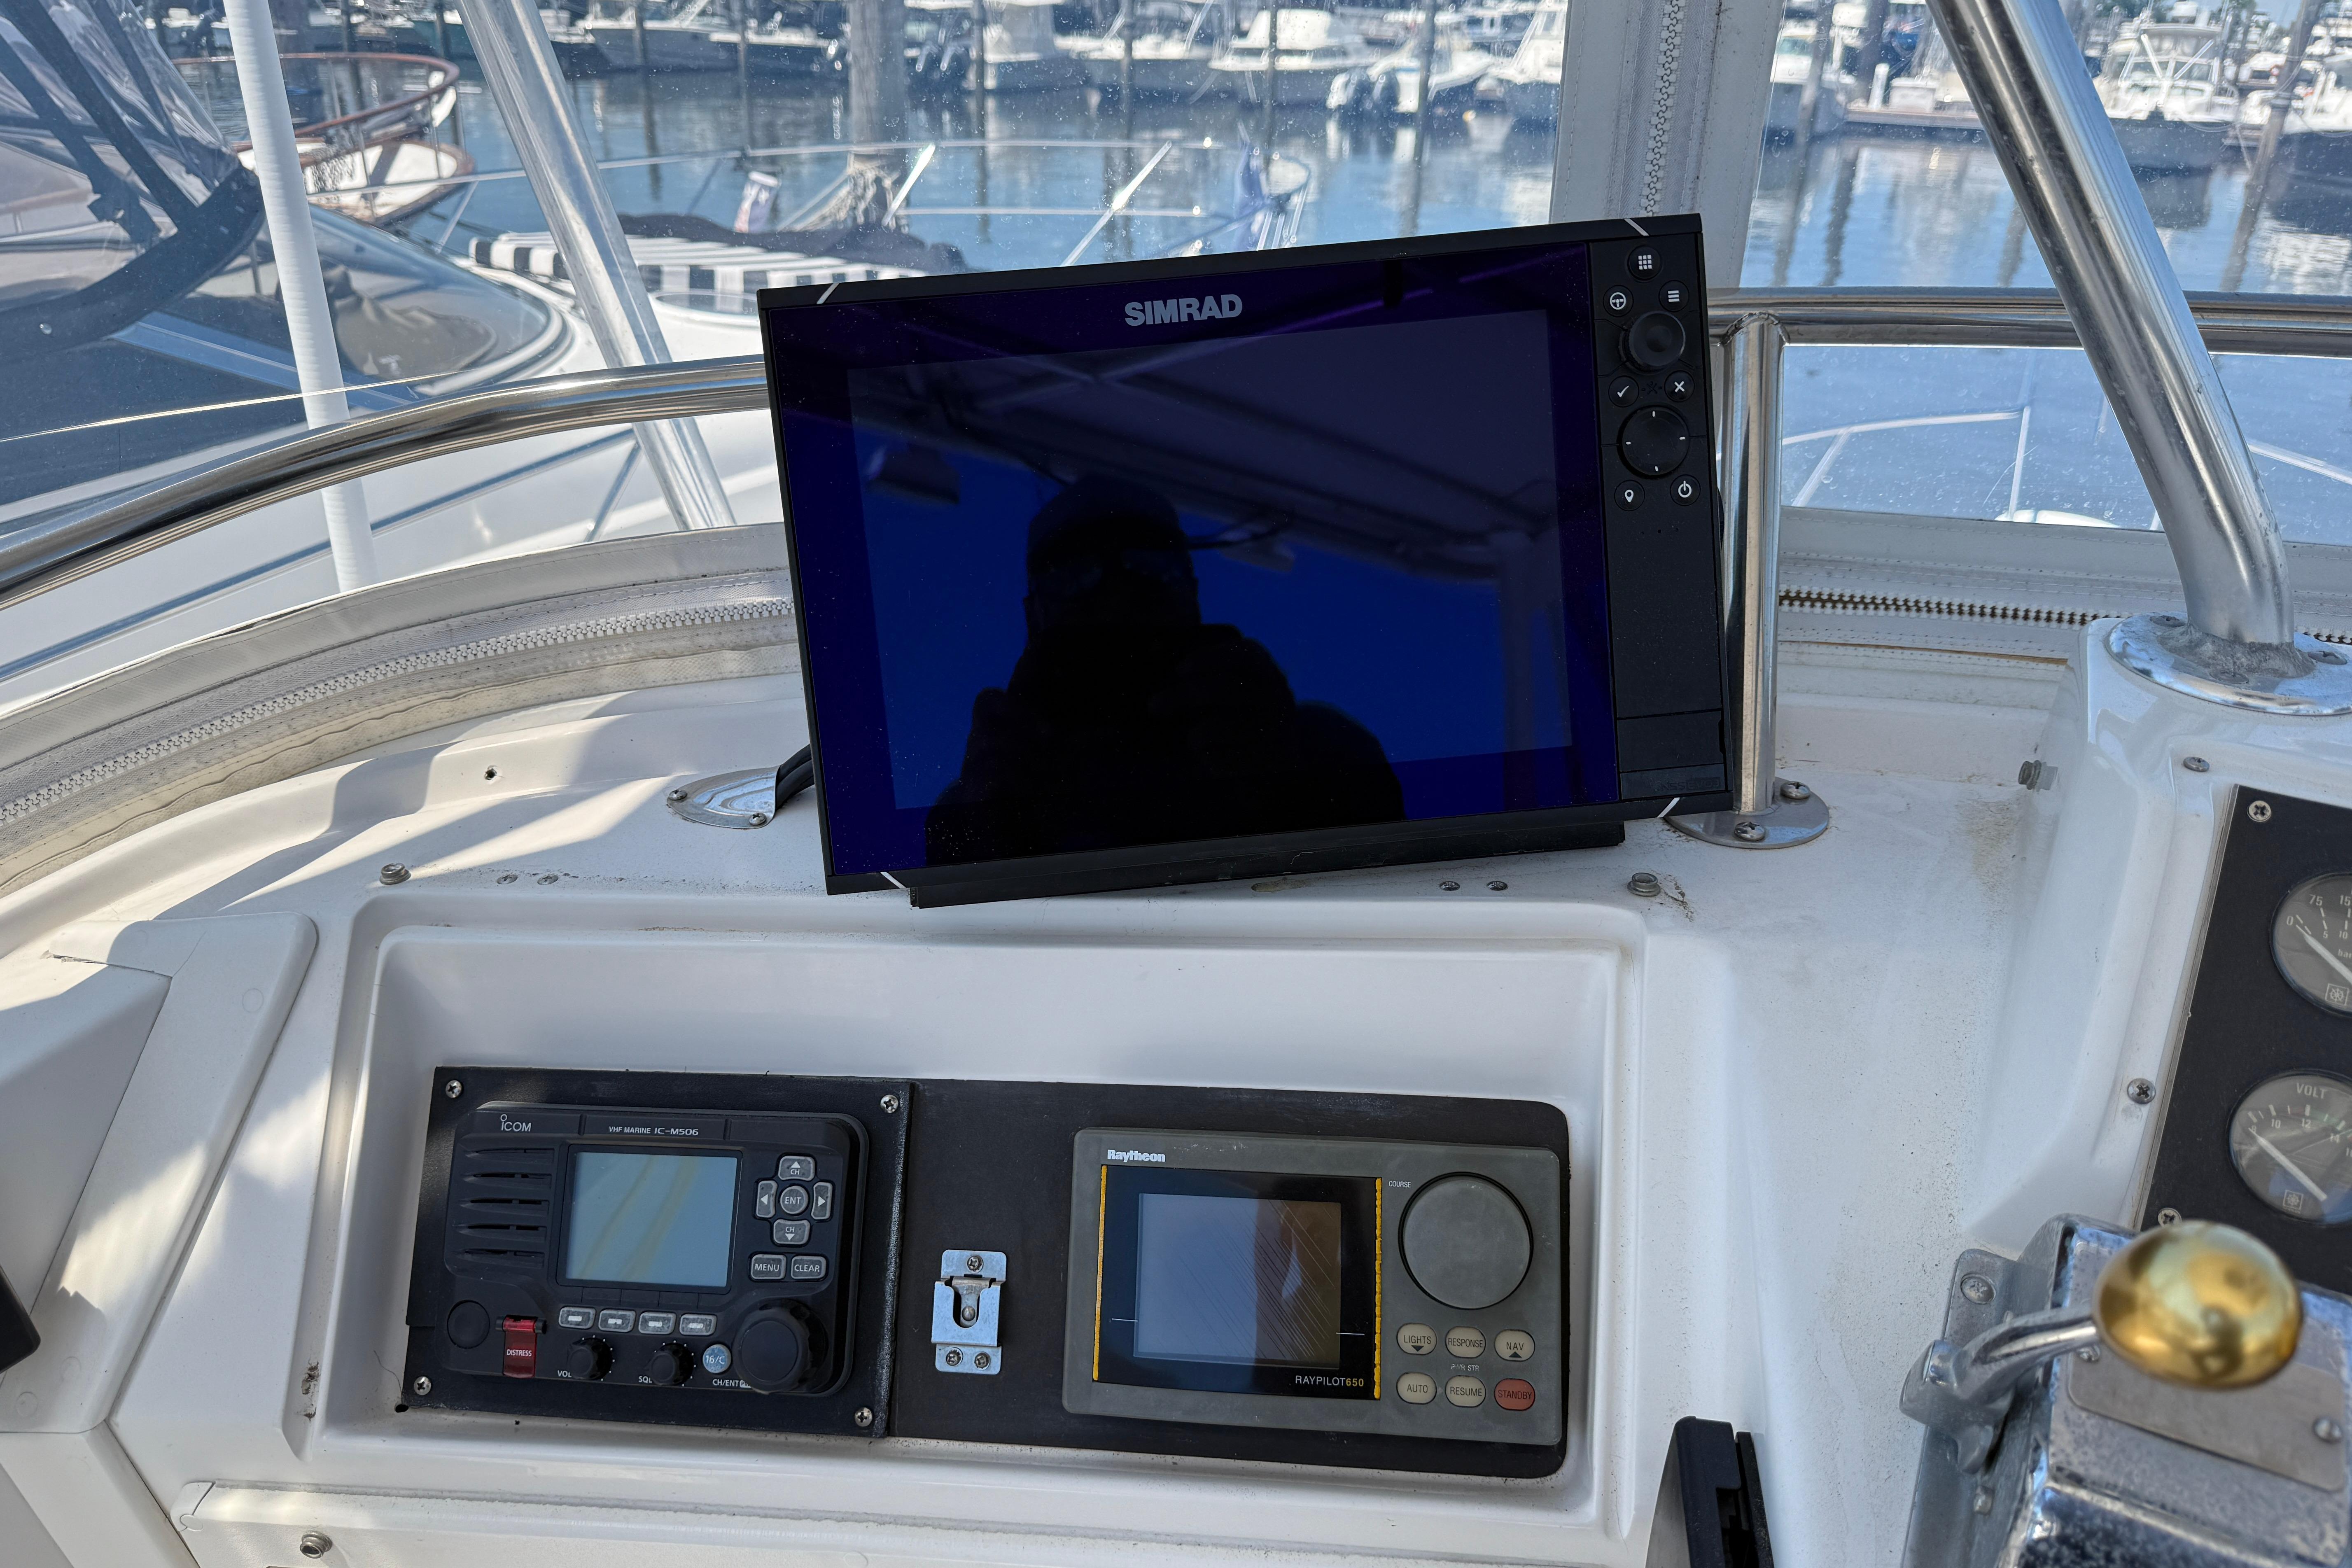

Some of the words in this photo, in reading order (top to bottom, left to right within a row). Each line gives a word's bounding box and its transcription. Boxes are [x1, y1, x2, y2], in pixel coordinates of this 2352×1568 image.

[1125, 294, 1243, 326] SIMRAD
[2309, 894, 2323, 906] 75
[2286, 916, 2294, 926] 0
[2339, 931, 2348, 939] 10
[2296, 1083, 2327, 1099] VOLT
[2271, 1119, 2281, 1129] 10
[2301, 1118, 2311, 1129] 12
[654, 1127, 699, 1136] IC-M506
[2330, 1133, 2340, 1143] 14
[1107, 1149, 1166, 1162] Raytheon
[755, 1263, 779, 1272] MENU
[794, 1264, 820, 1272] CLEAR
[1404, 1335, 1432, 1344] LIGHTS
[1448, 1337, 1483, 1348] RESPONSE
[1506, 1342, 1524, 1351] NAV
[506, 1349, 532, 1357] DISTRESS
[705, 1355, 725, 1365] 16/C
[638, 1376, 653, 1384] SQL
[712, 1379, 740, 1387] CH/ENT
[1295, 1375, 1364, 1387] RAYPILOT650
[1407, 1384, 1428, 1393] AUTO
[1449, 1386, 1482, 1396] RESUME
[1498, 1389, 1533, 1400] STANDBY
